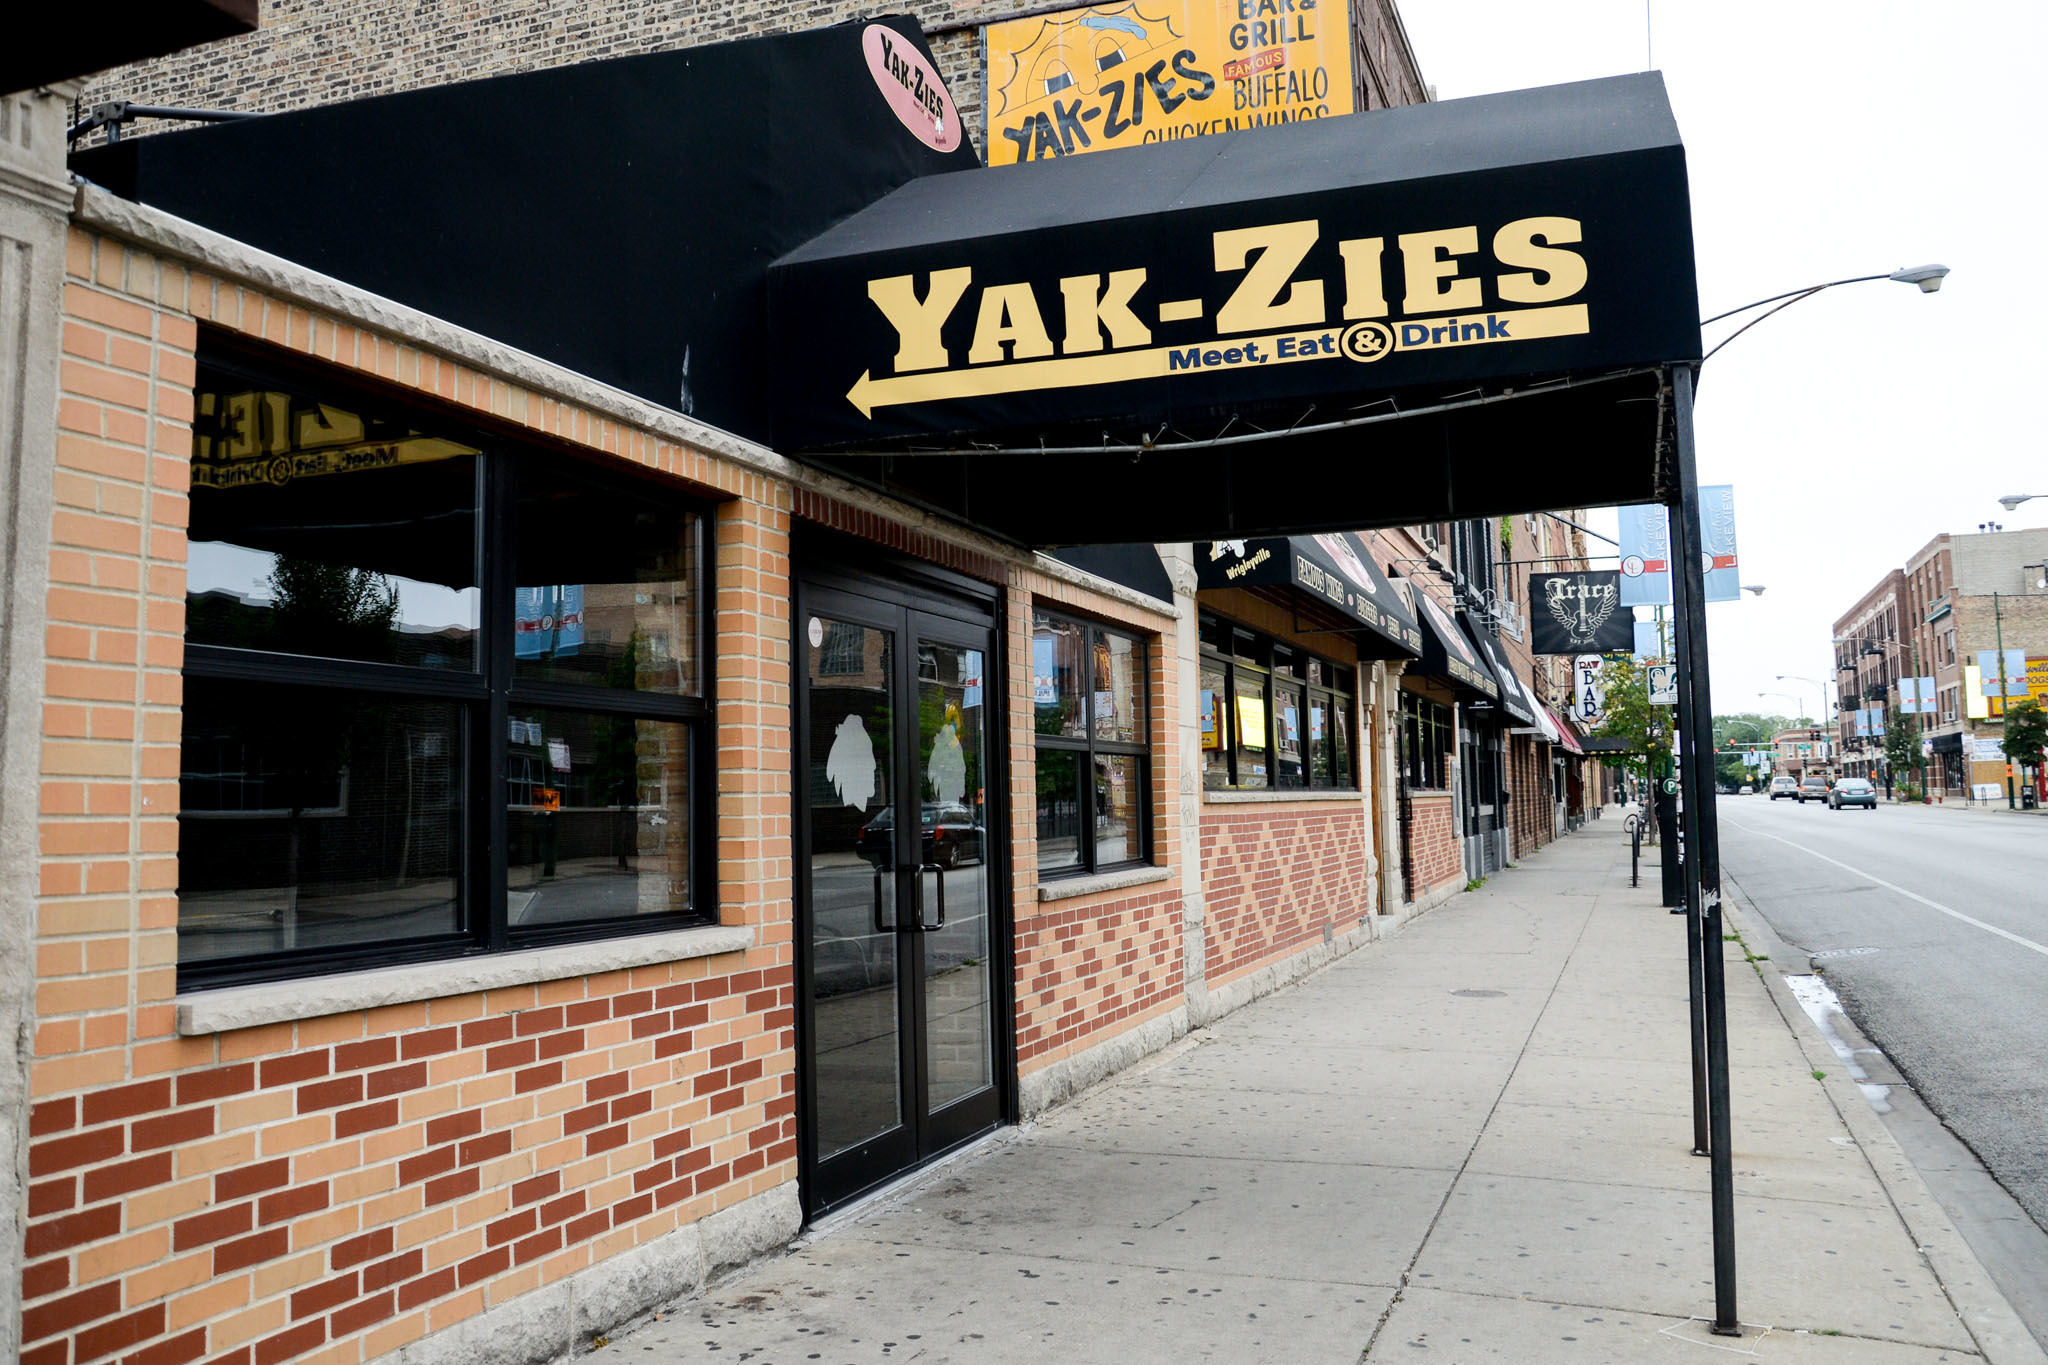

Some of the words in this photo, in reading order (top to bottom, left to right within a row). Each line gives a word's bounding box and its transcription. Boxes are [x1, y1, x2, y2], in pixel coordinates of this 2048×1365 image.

[1230, 15, 1315, 51] GRILL
[881, 31, 943, 120] YAK-ZIES
[1228, 51, 1282, 77] FAMOUS
[1003, 49, 1215, 163] YAK-ZIES
[1234, 66, 1329, 111] BUFFALO
[868, 216, 1588, 373] YAK-ZIES
[1169, 342, 1269, 370] Meet,
[1276, 333, 1335, 359] Eat
[1354, 330, 1382, 354] &
[1402, 315, 1512, 348] Drink
[1654, 503, 1667, 571] LAKEVIE
[1722, 490, 1737, 567] LAKEVIEW
[1226, 547, 1271, 580] Wrigleyville
[1297, 554, 1325, 593] FAMOUS
[1545, 577, 1615, 606] Trace
[1584, 670, 1597, 716] BAR
[1667, 780, 1676, 792] P
